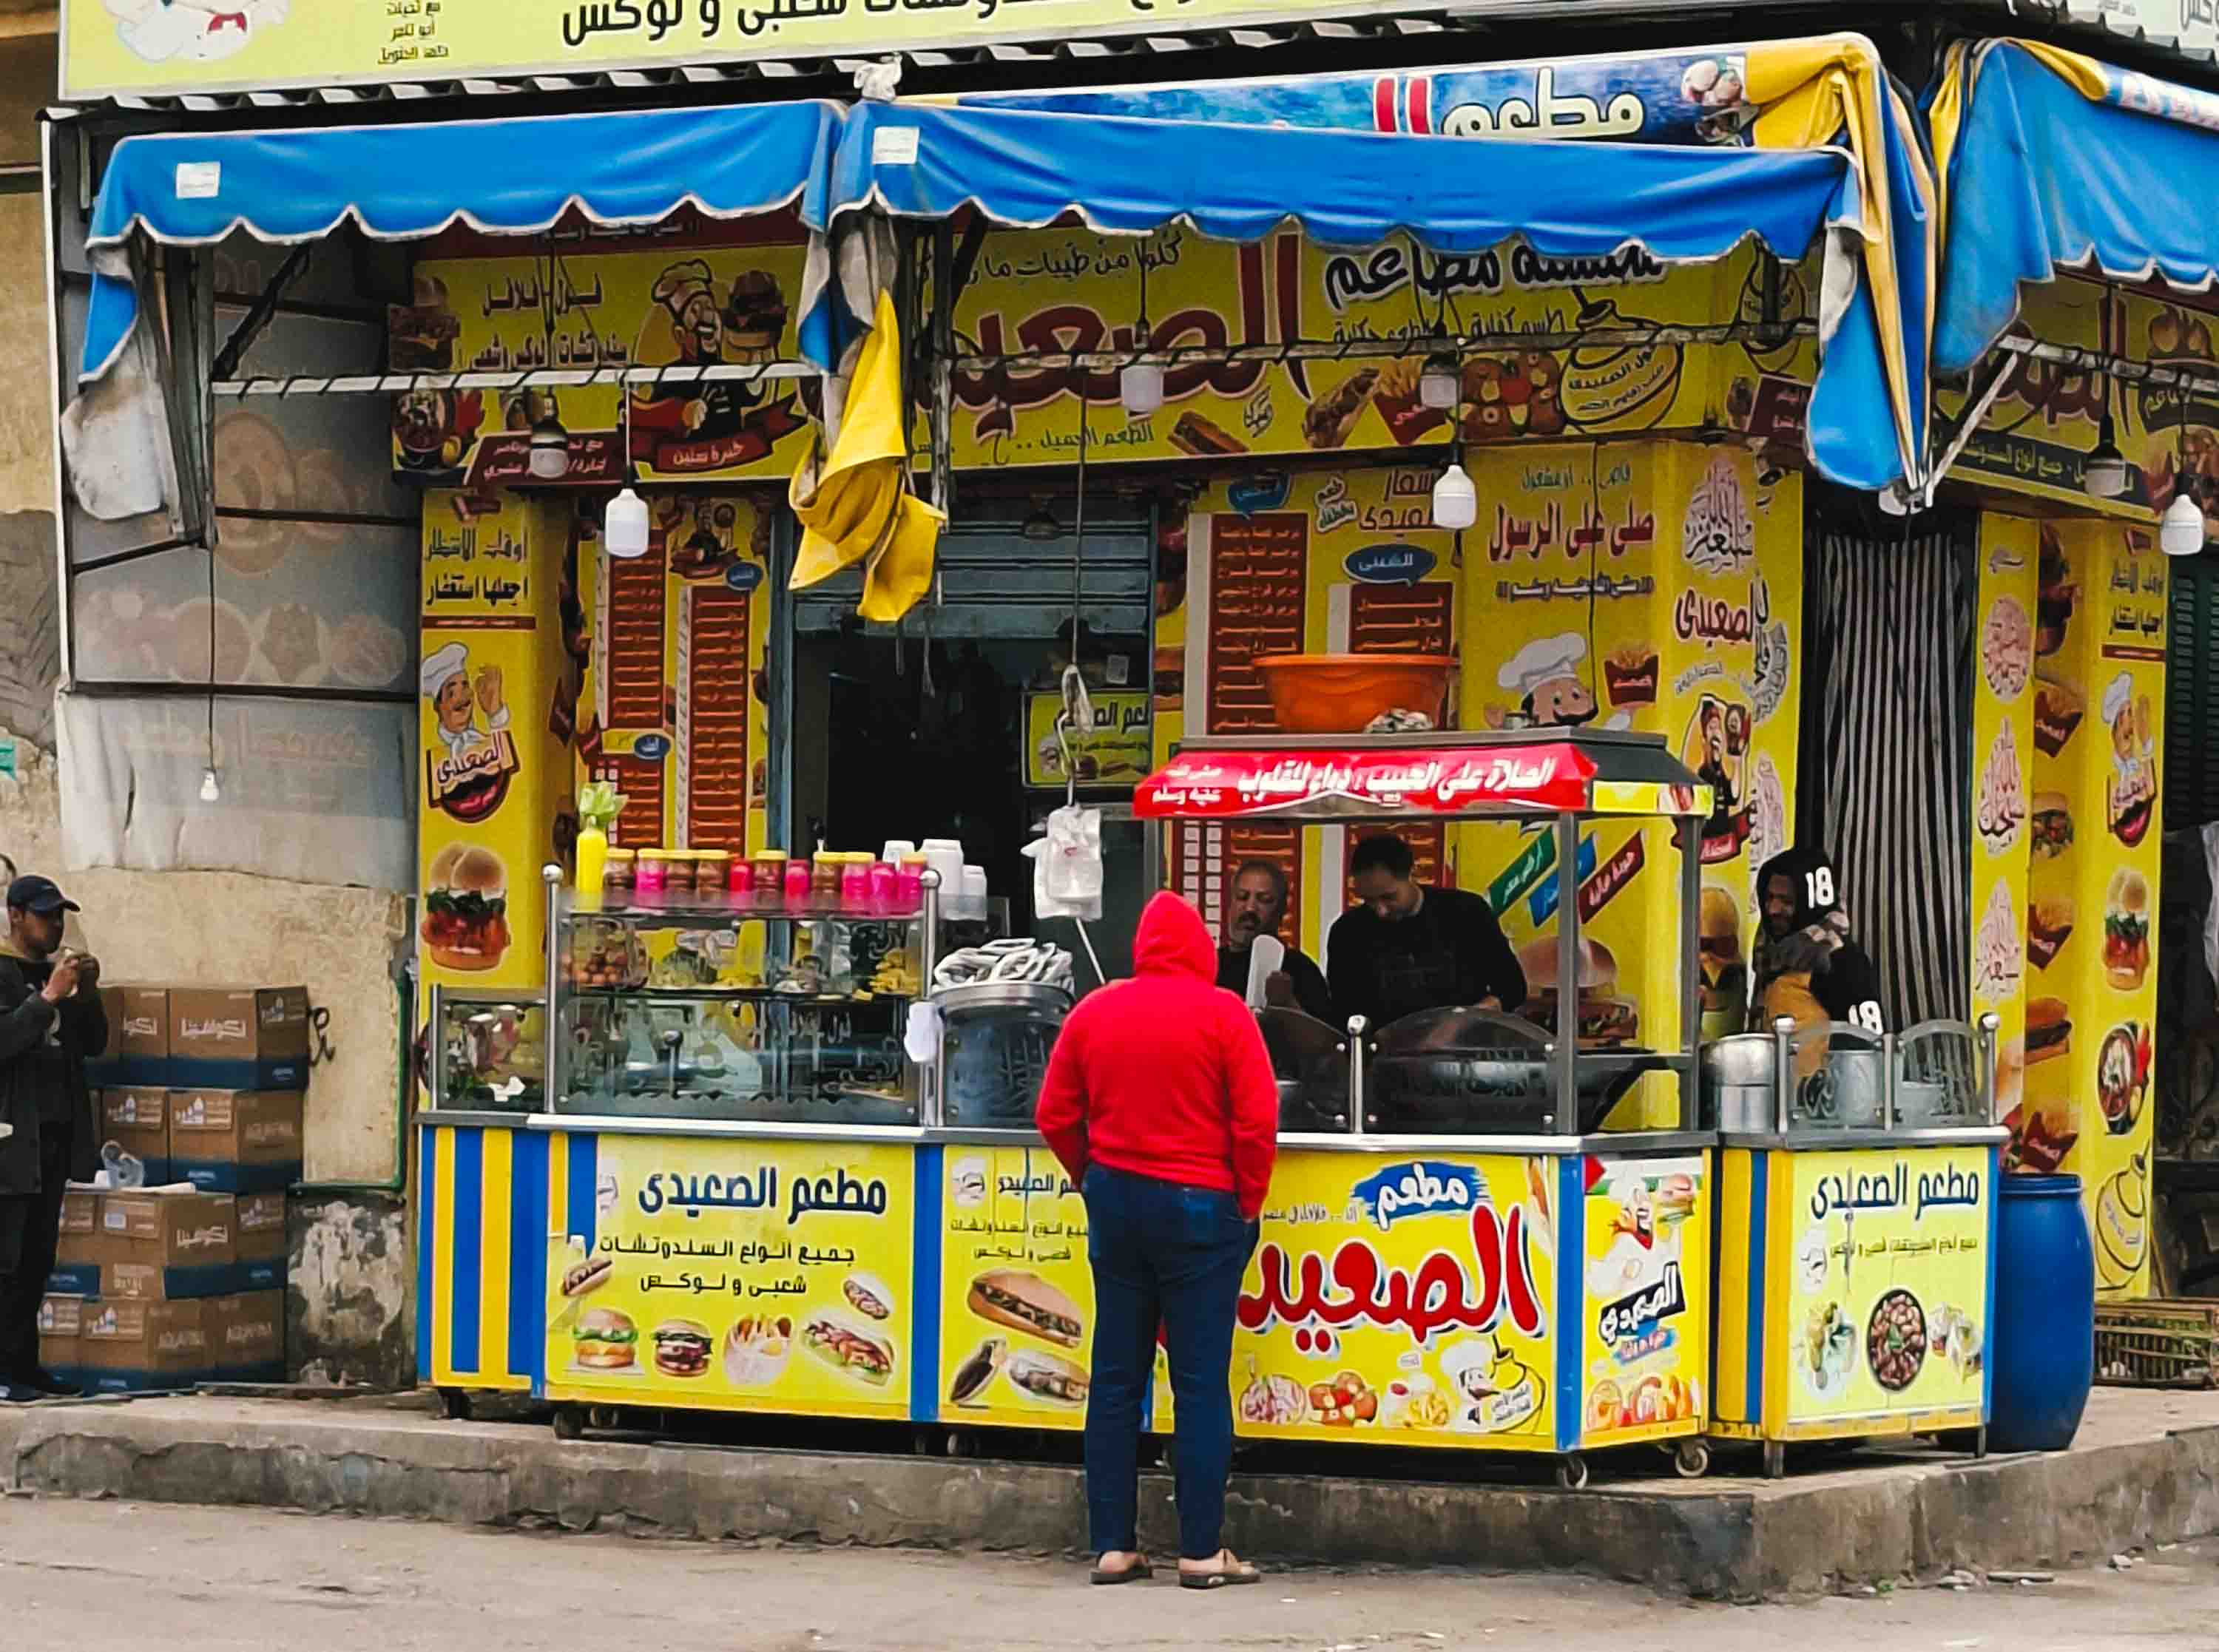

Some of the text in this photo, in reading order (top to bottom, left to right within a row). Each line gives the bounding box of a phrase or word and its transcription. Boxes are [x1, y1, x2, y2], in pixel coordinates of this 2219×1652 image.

[911, 234, 1313, 438] الصعيد
[1805, 865, 1835, 910] 18
[637, 1166, 888, 1225] مطعم الصعيدى
[1377, 1163, 1470, 1233] مطعم
[1915, 1165, 1980, 1222] مطعم
[599, 1232, 855, 1267] جميع انواع السندوتشات
[732, 1276, 743, 1296] و
[1237, 1205, 1539, 1353] الصعيد
